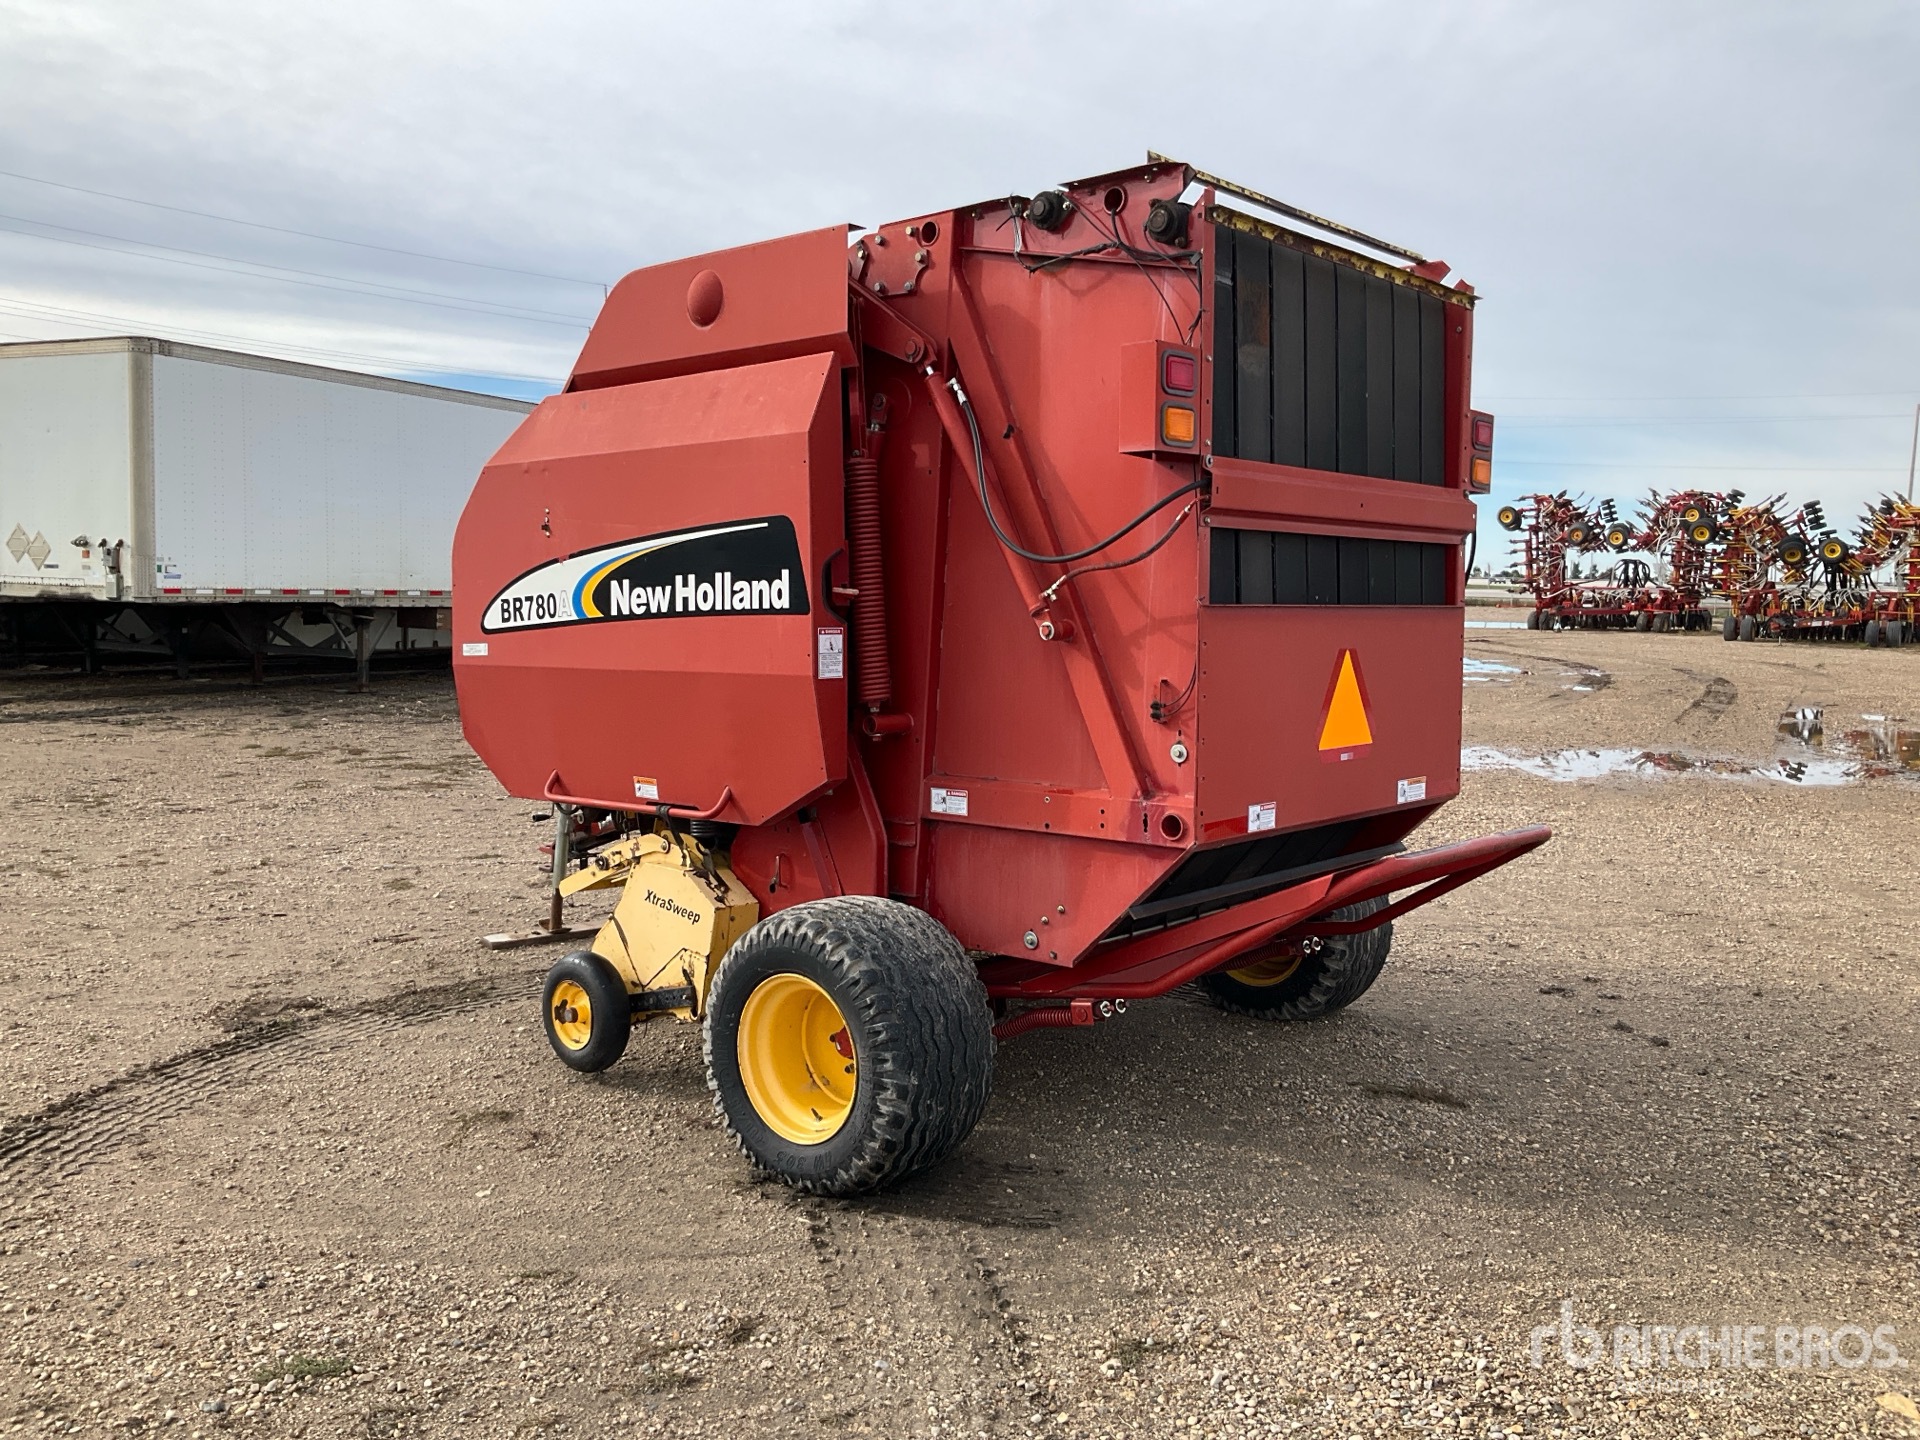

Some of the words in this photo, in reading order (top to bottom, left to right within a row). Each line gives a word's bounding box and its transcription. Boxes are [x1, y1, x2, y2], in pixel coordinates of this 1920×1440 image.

[501, 590, 572, 623] BR780A
[610, 579, 671, 616] New
[675, 569, 790, 612] Holland
[644, 889, 701, 925] XtraSweep
